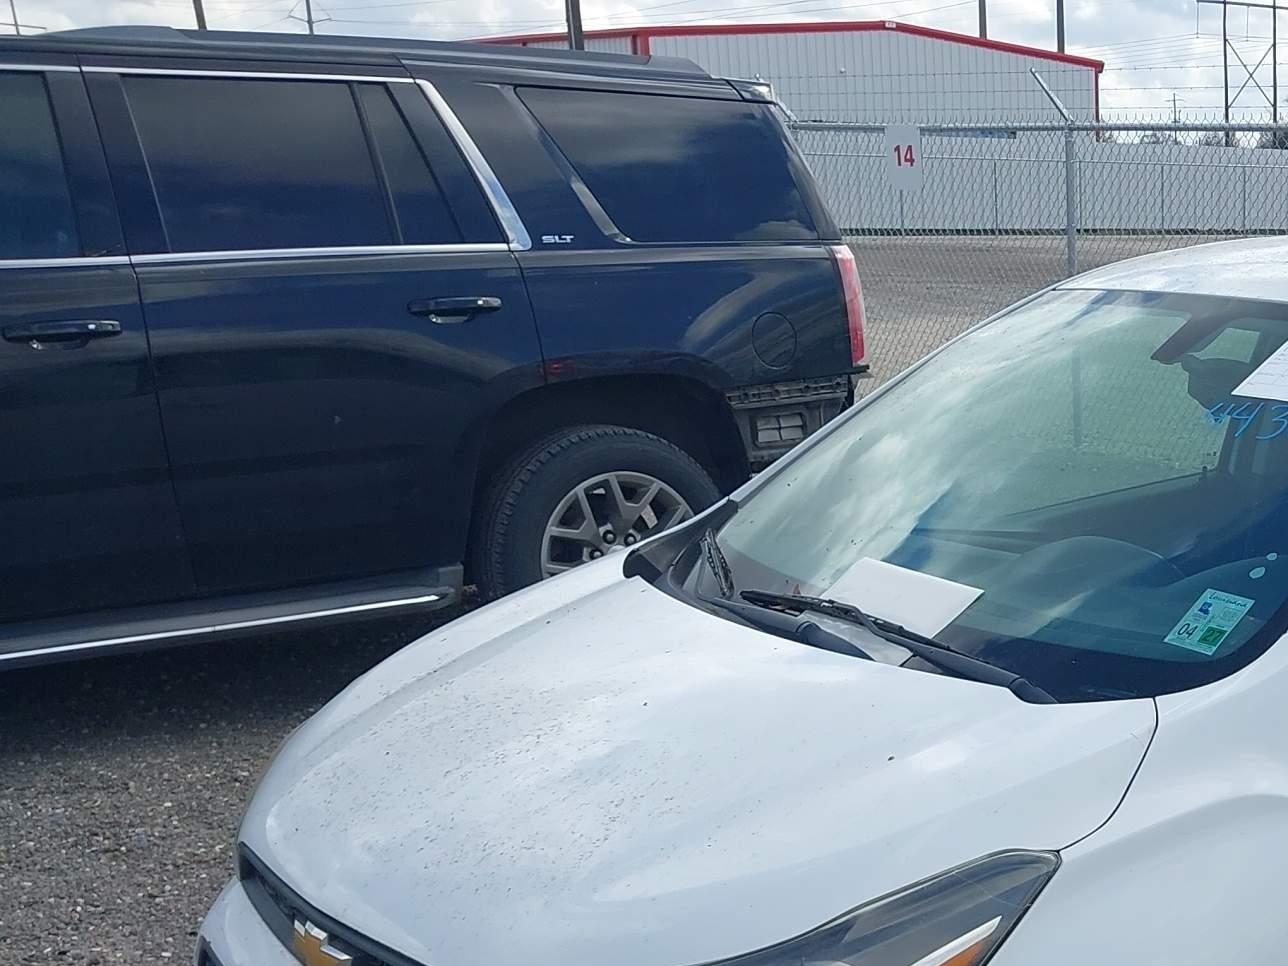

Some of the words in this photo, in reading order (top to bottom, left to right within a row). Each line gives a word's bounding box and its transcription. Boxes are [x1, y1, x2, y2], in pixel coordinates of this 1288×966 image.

[893, 144, 916, 168] 14
[541, 234, 575, 244] SLT
[1177, 623, 1199, 640] 04
